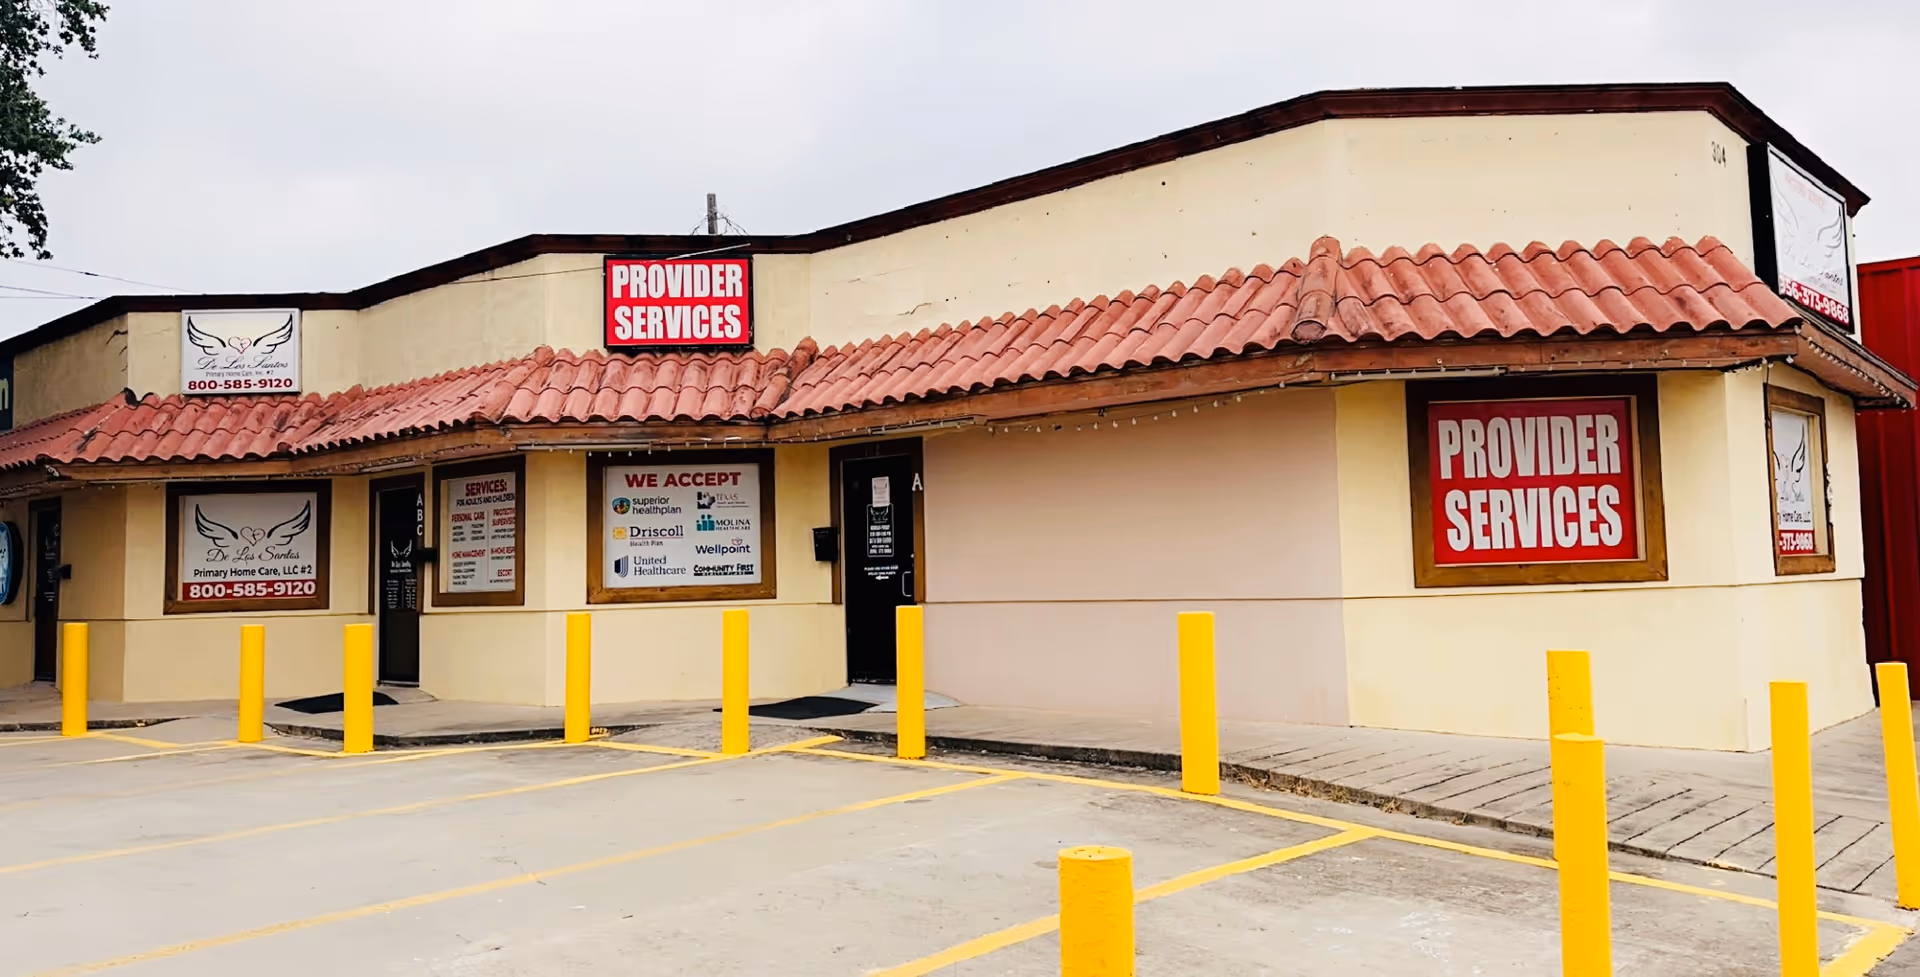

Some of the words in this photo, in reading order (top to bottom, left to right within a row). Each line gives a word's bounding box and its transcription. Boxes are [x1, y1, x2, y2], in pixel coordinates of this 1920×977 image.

[1711, 141, 1726, 168] 304
[612, 263, 743, 299] PROVIDER
[614, 304, 742, 340] SERVICES
[195, 357, 218, 370] De
[220, 356, 246, 370] Los
[247, 355, 288, 369] Santos
[188, 378, 293, 390] 800-585-9120
[1438, 414, 1621, 479] PROVIDER
[624, 473, 658, 488] WE
[663, 472, 741, 487] ACCEPT
[912, 473, 923, 491] A
[465, 479, 508, 497] SERVICES:
[416, 493, 423, 506] A
[632, 496, 670, 506] superior
[716, 493, 738, 501] TEXAS
[417, 509, 423, 522] B
[632, 505, 682, 516] healthplan
[1444, 484, 1623, 552] SERVICES
[416, 524, 423, 536] C
[630, 525, 684, 537] Driscoll
[206, 548, 230, 563] De
[231, 546, 255, 564] Los
[258, 546, 300, 561] Santos
[695, 543, 751, 556] Wellpoint
[633, 555, 667, 565] United
[194, 568, 232, 579] Primary
[230, 567, 256, 577] Home
[258, 566, 281, 577] Care,
[283, 565, 298, 575] LLC
[300, 564, 312, 575] #2
[633, 565, 687, 576] Healthcare
[189, 581, 316, 598] 800-585-9120
